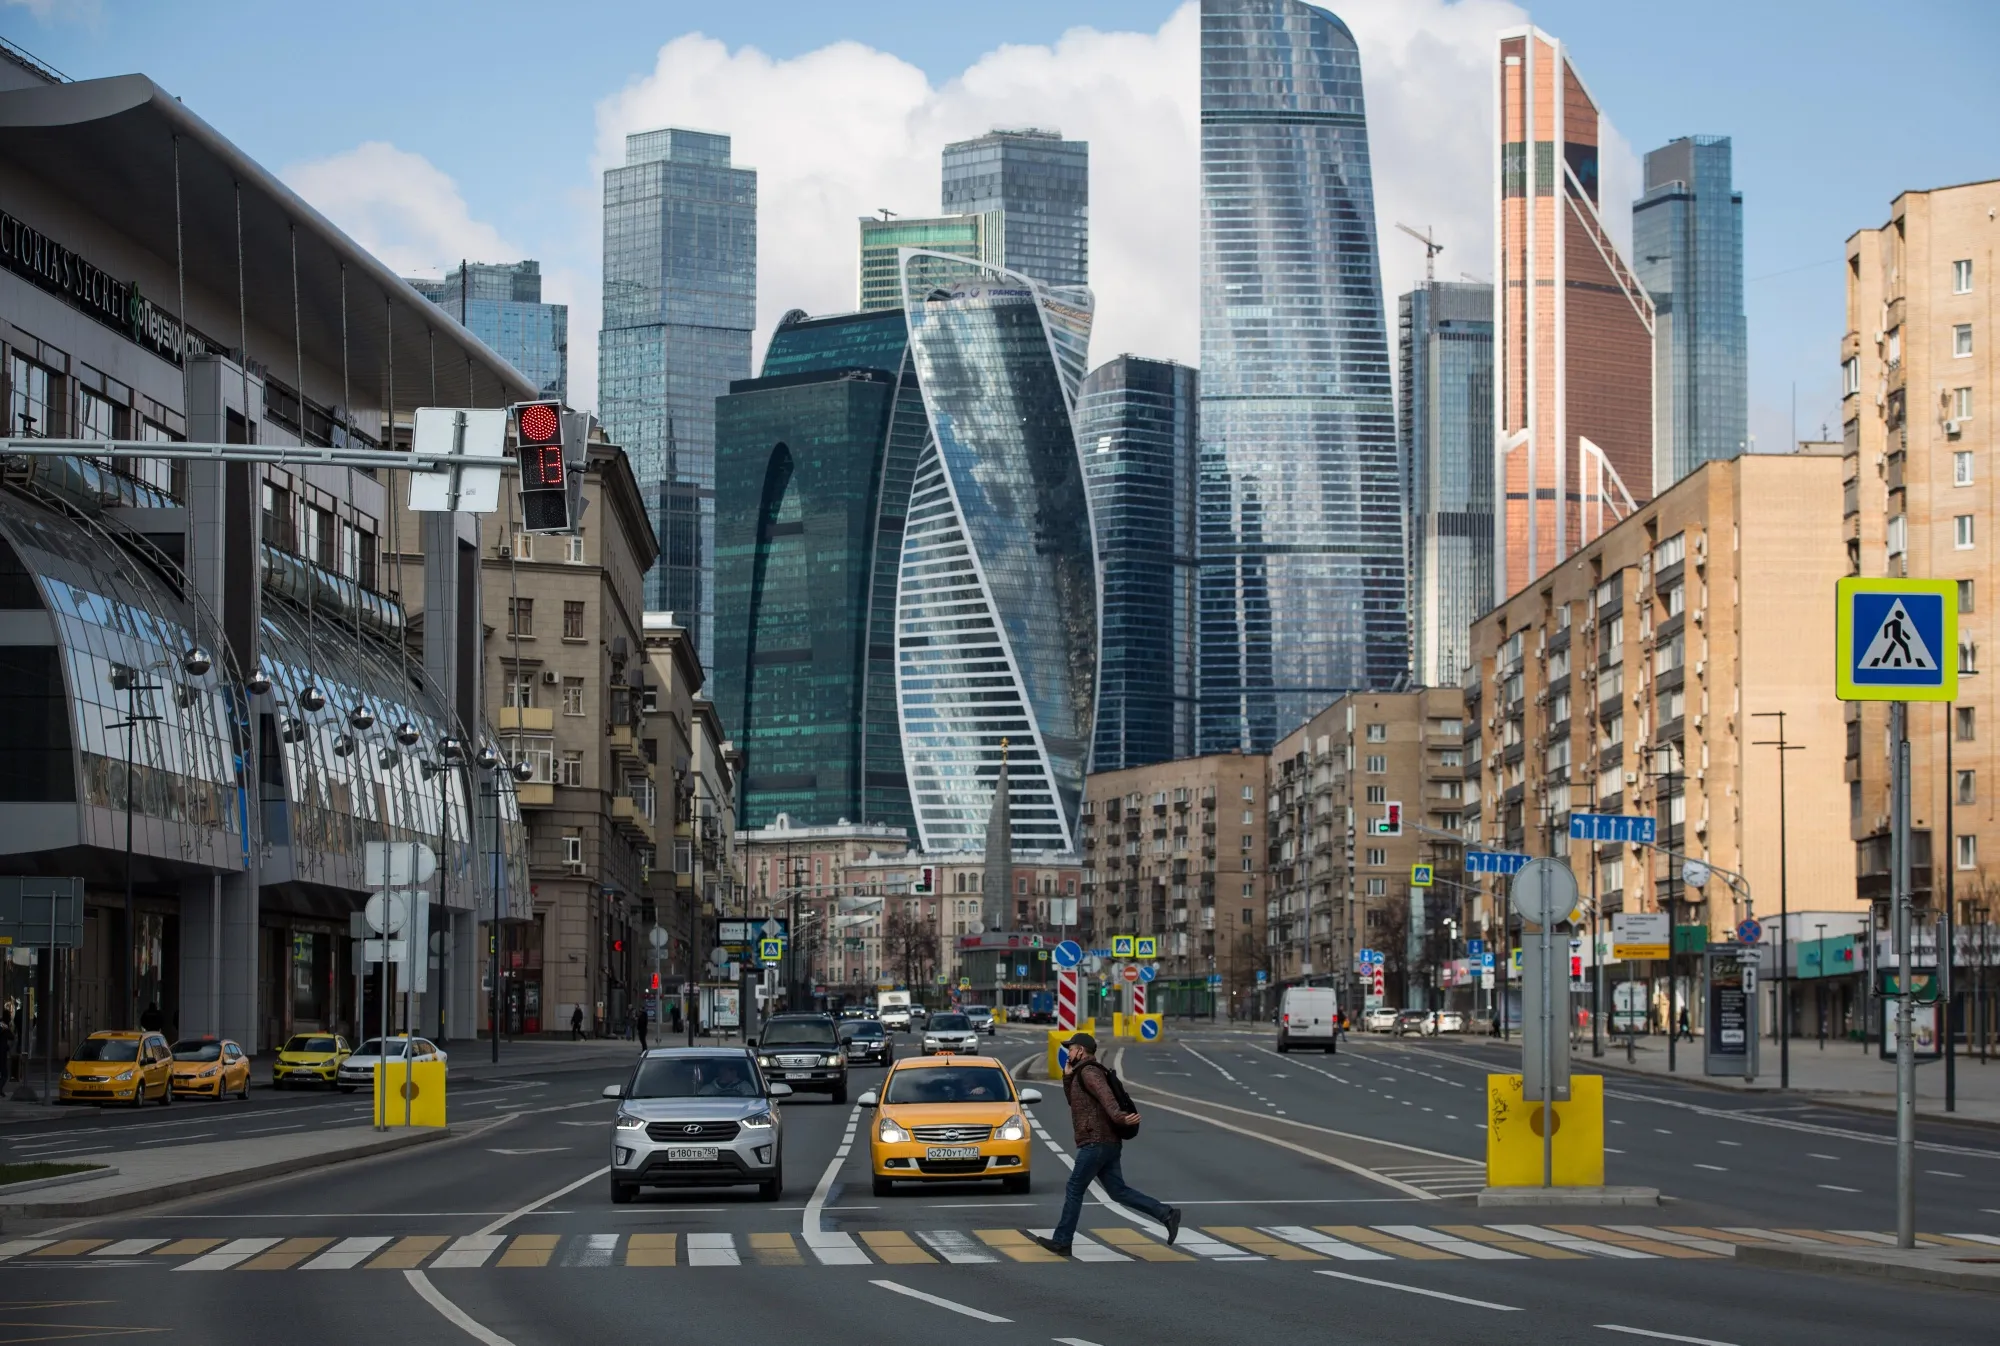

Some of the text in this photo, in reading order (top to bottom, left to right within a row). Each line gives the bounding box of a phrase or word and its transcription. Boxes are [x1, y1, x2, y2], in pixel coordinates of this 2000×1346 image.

[75, 254, 128, 324] SECRET
[539, 446, 562, 483] 13
[670, 1148, 703, 1158] В180ТВ
